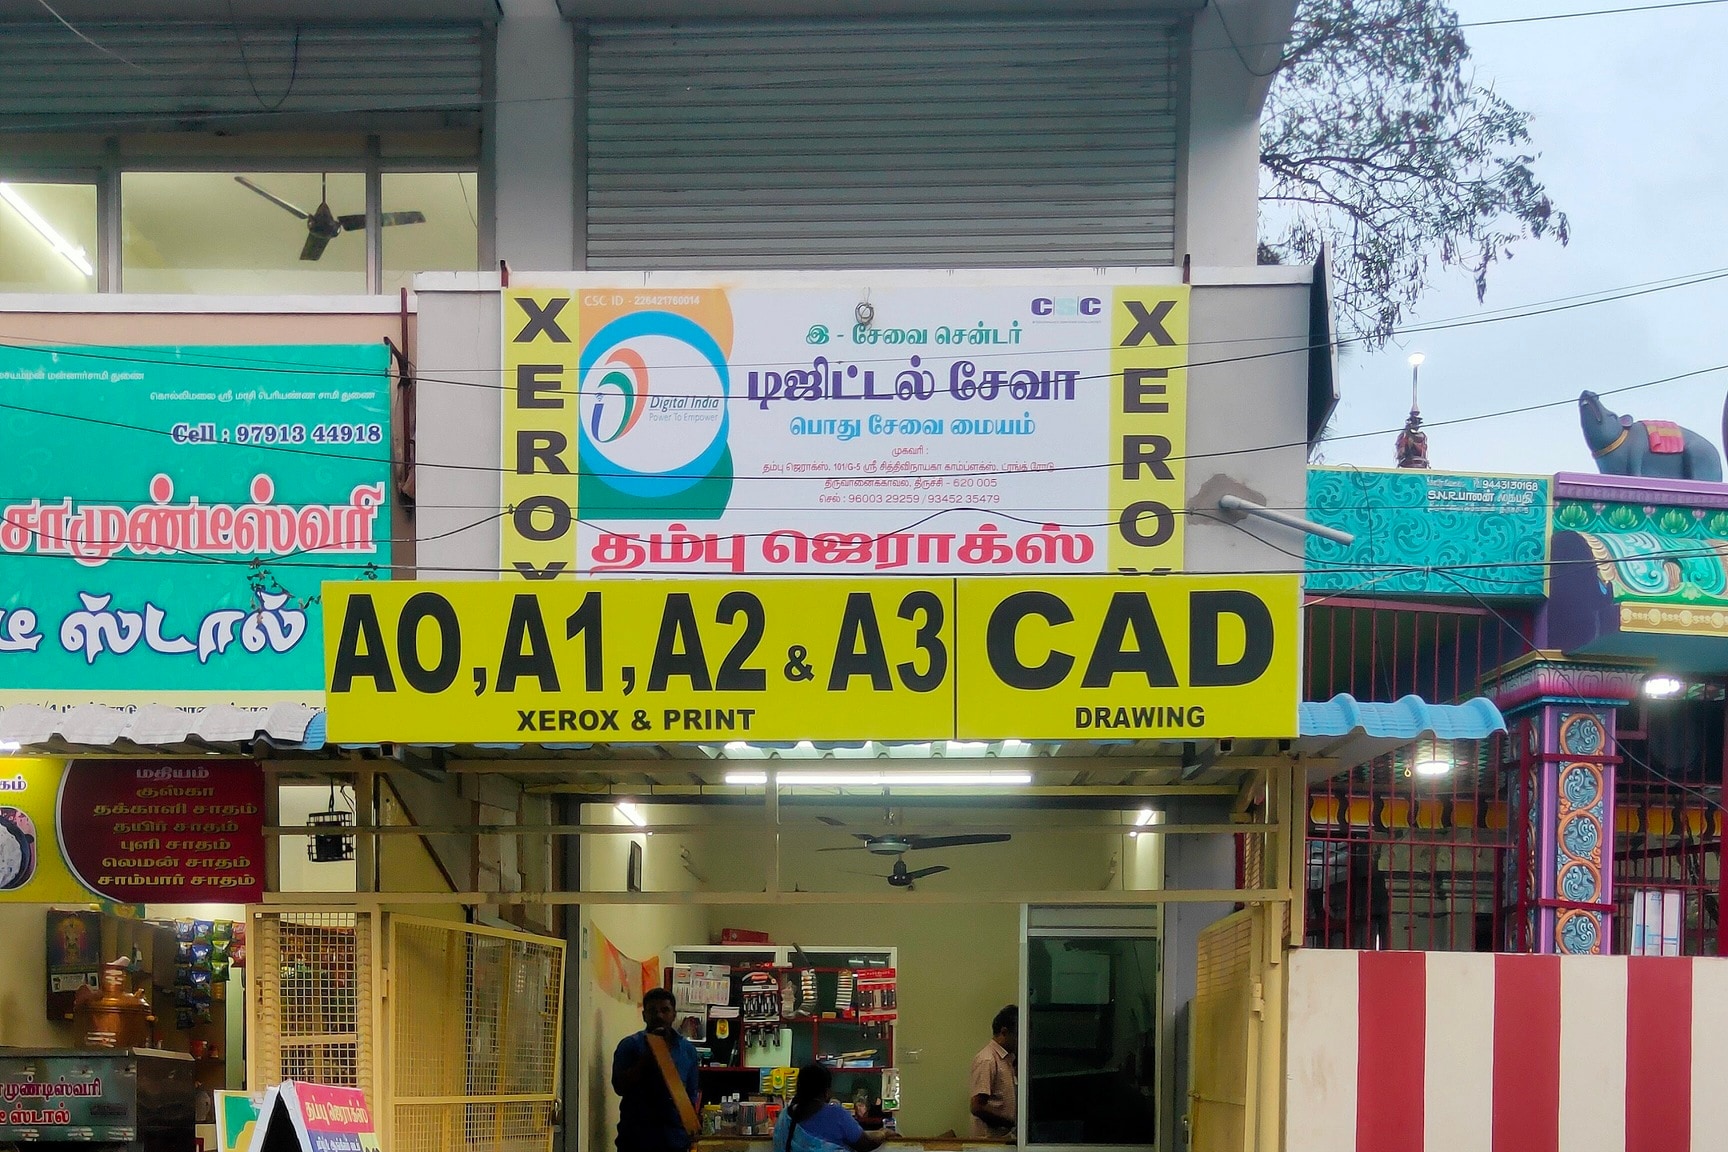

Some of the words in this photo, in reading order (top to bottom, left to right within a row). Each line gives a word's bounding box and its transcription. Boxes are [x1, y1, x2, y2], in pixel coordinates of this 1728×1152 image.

[584, 296, 607, 306] CSC
[611, 296, 623, 306] ID
[805, 323, 830, 345] இ
[852, 322, 928, 345] சேவை
[935, 320, 1022, 345] சென்டர்
[748, 355, 935, 410] டிஜிட்டல்
[950, 360, 1081, 401] சேவா
[650, 395, 687, 412] Digital
[690, 395, 719, 409] India
[649, 412, 672, 422] Power
[673, 412, 682, 421] To
[684, 412, 718, 424] Empower
[790, 416, 861, 441] பொது
[868, 413, 943, 437] சேவை
[951, 411, 1036, 437] மையம்
[172, 424, 215, 443] Cell
[236, 425, 305, 443] 97913
[312, 425, 382, 443] 44918
[1119, 301, 1178, 576] XERO
[953, 478, 974, 487] 620
[976, 478, 998, 487] 005
[849, 494, 883, 503] 96003
[886, 494, 920, 503] 29259
[928, 494, 963, 503] 93452
[966, 494, 1000, 503] 35479
[589, 523, 745, 577] தம்பு
[762, 522, 1095, 570] ஜெராக்ஸ்
[61, 592, 306, 664] ஸ்டால்
[783, 644, 816, 682] &
[827, 590, 948, 693] A3
[986, 589, 1274, 690] CAD
[516, 709, 620, 731] XEROX
[630, 709, 652, 731] &
[664, 708, 756, 731] PRINT
[1075, 706, 1206, 729] DRAWING
[93, 803, 187, 816] தக்காளி
[193, 803, 258, 816] சாதம்
[173, 820, 239, 833] சாதம்
[120, 838, 160, 852] புளி
[166, 838, 231, 852] சாதம்
[102, 856, 179, 868] லெமன்
[185, 856, 250, 870] சாதம்
[98, 874, 186, 886] சாம்பார்
[190, 874, 256, 888] சாதம்
[10, 1102, 70, 1124] ஸ்டால்
